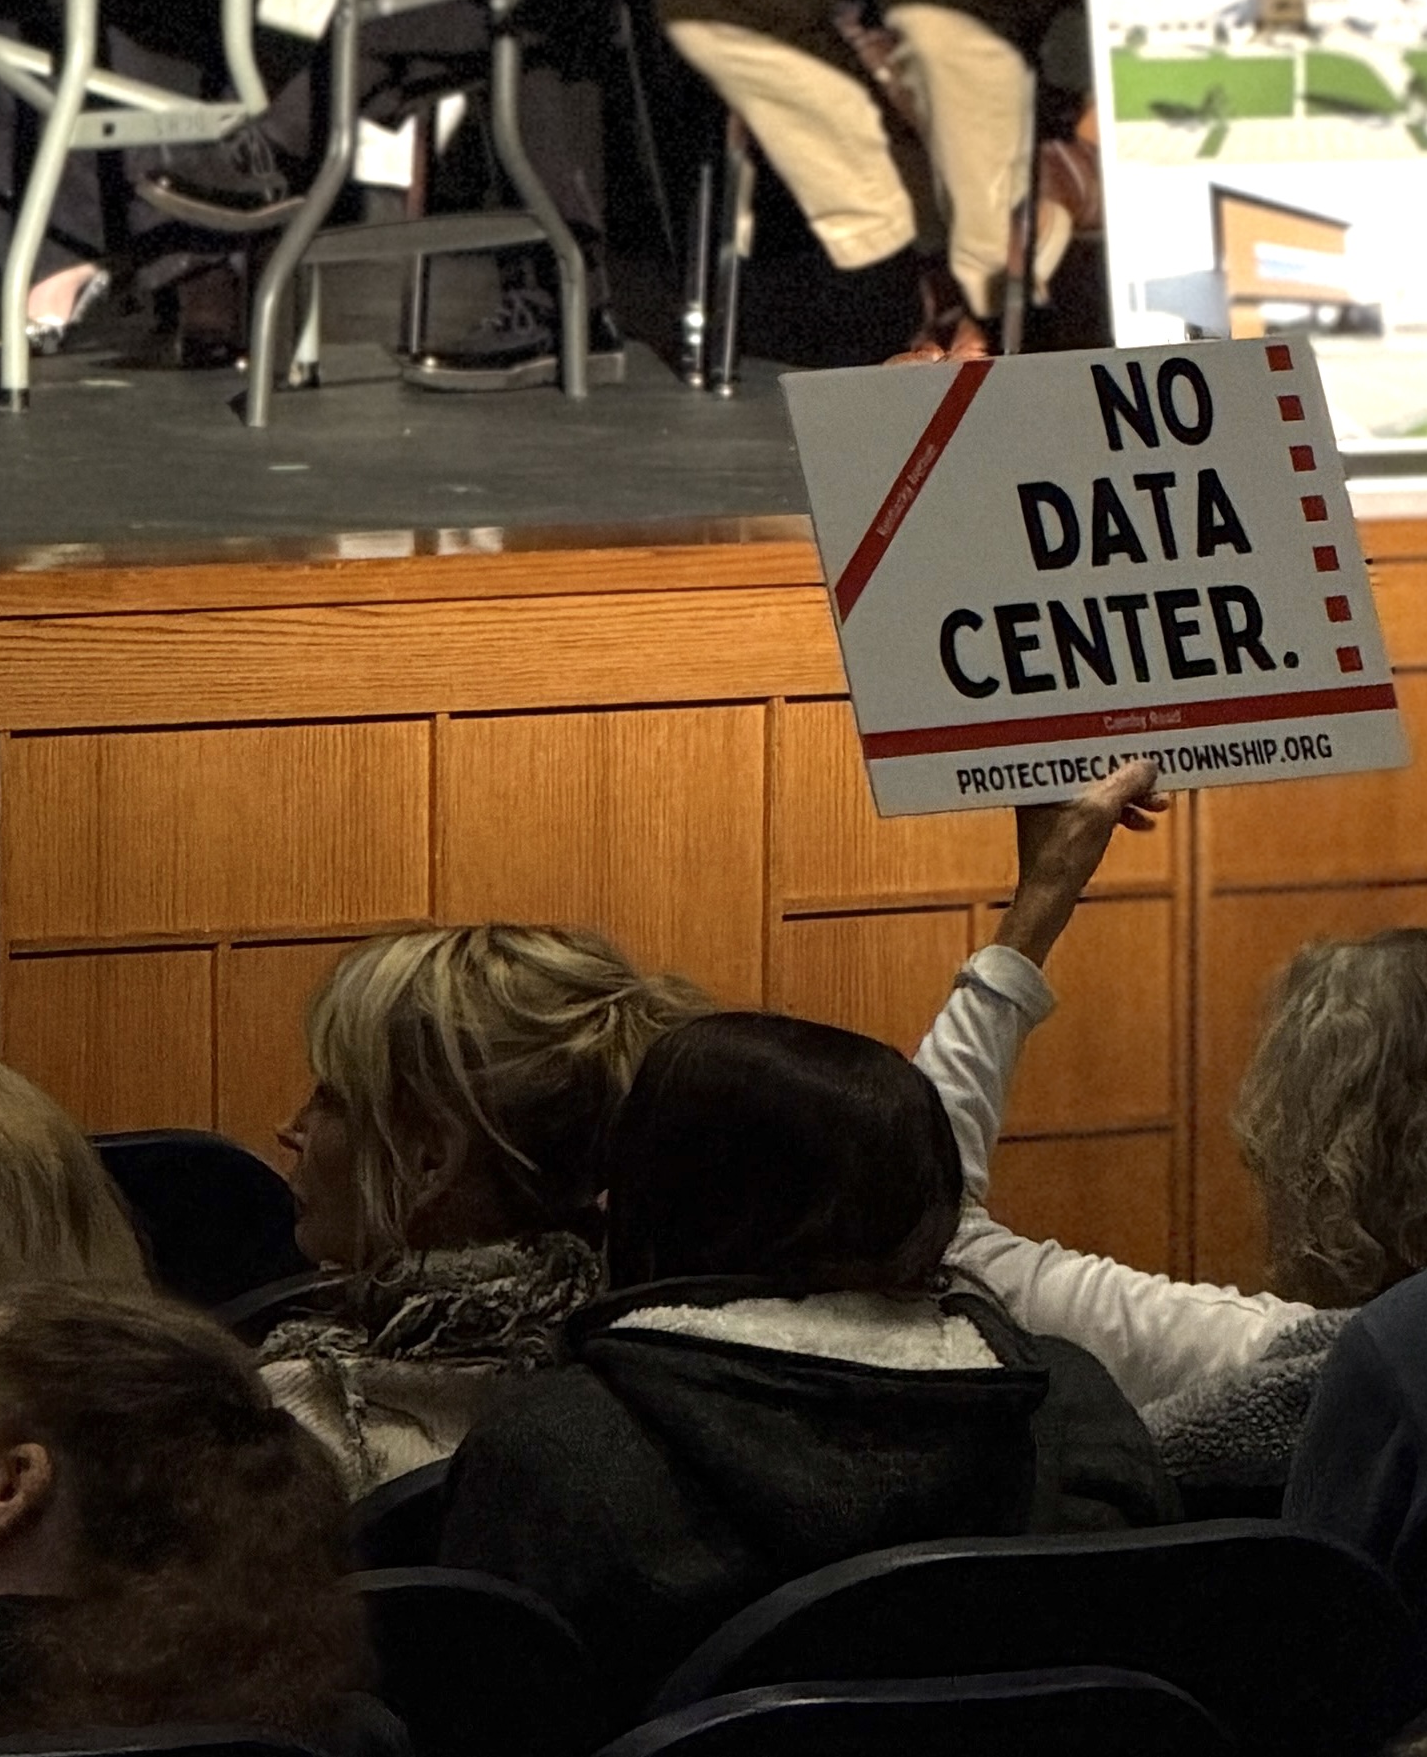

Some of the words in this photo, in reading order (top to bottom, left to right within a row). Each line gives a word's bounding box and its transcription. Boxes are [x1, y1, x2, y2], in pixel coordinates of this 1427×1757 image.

[1090, 357, 1213, 451] NO
[1016, 468, 1253, 571] DATA
[939, 584, 1300, 699] CENTER.
[957, 733, 1333, 794] PROTECTDECATRTOWNSHIP.ORG
